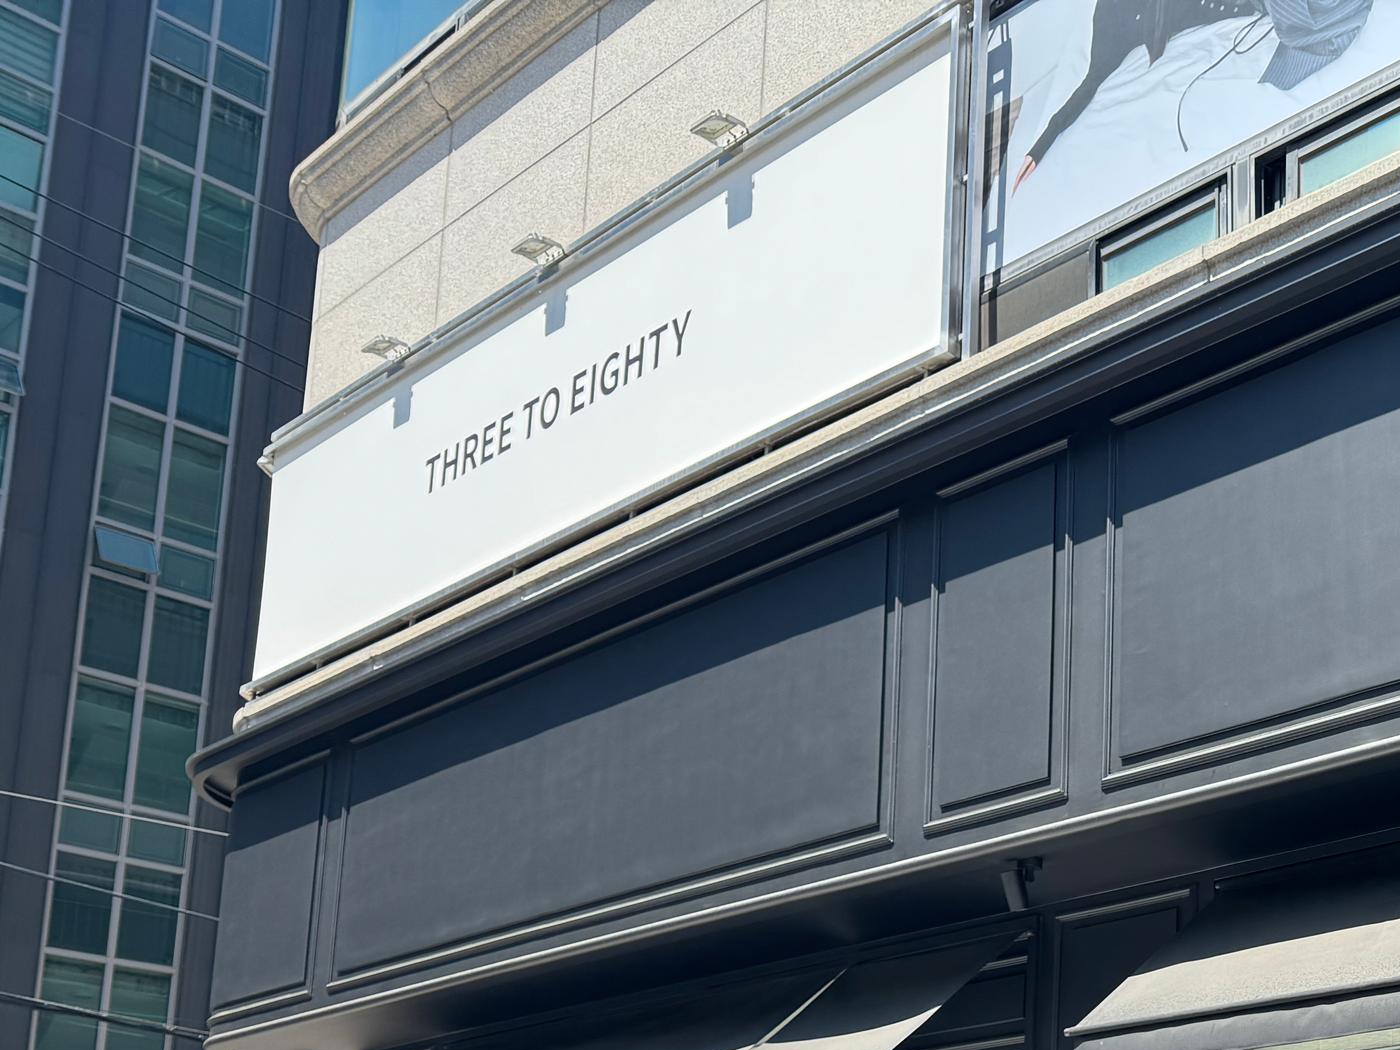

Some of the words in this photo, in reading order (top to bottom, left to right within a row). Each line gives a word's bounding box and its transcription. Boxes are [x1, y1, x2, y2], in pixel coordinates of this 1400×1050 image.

[425, 411, 514, 494] THREE
[523, 386, 560, 440] TO
[570, 309, 693, 416] EIGHTY
